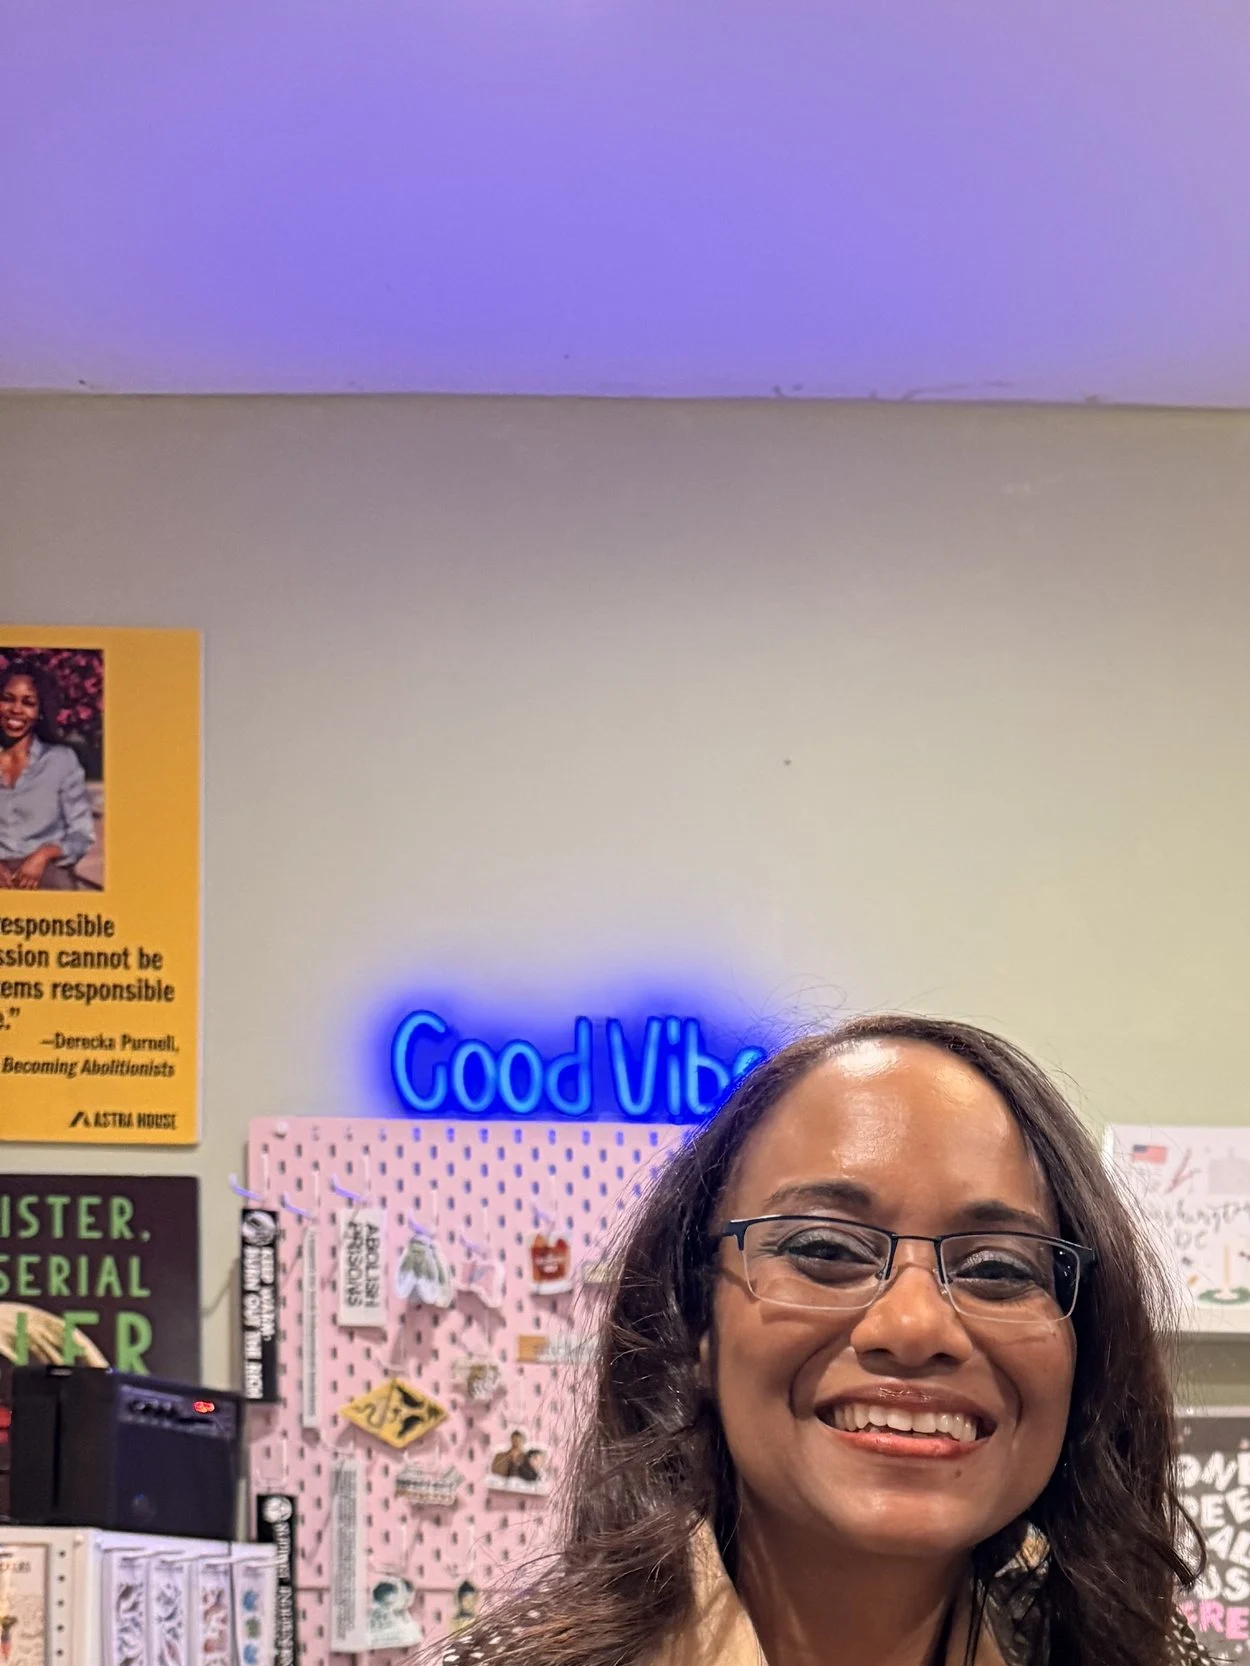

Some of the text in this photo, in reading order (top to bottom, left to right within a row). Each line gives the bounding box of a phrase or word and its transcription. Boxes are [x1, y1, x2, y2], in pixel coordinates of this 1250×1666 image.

[0, 913, 115, 941] esponsible
[0, 942, 163, 971] sion cannot be
[0, 978, 175, 1007] ems responsible
[1, 1056, 175, 1079] Becoming Abolitionists
[391, 1009, 594, 1116] Good
[94, 1111, 177, 1131] ASTRA HOUSE
[346, 1221, 363, 1308] PRISONS
[365, 1224, 381, 1309] ABOLISH
[243, 1291, 262, 1328] OUT
[244, 1331, 262, 1361] THE
